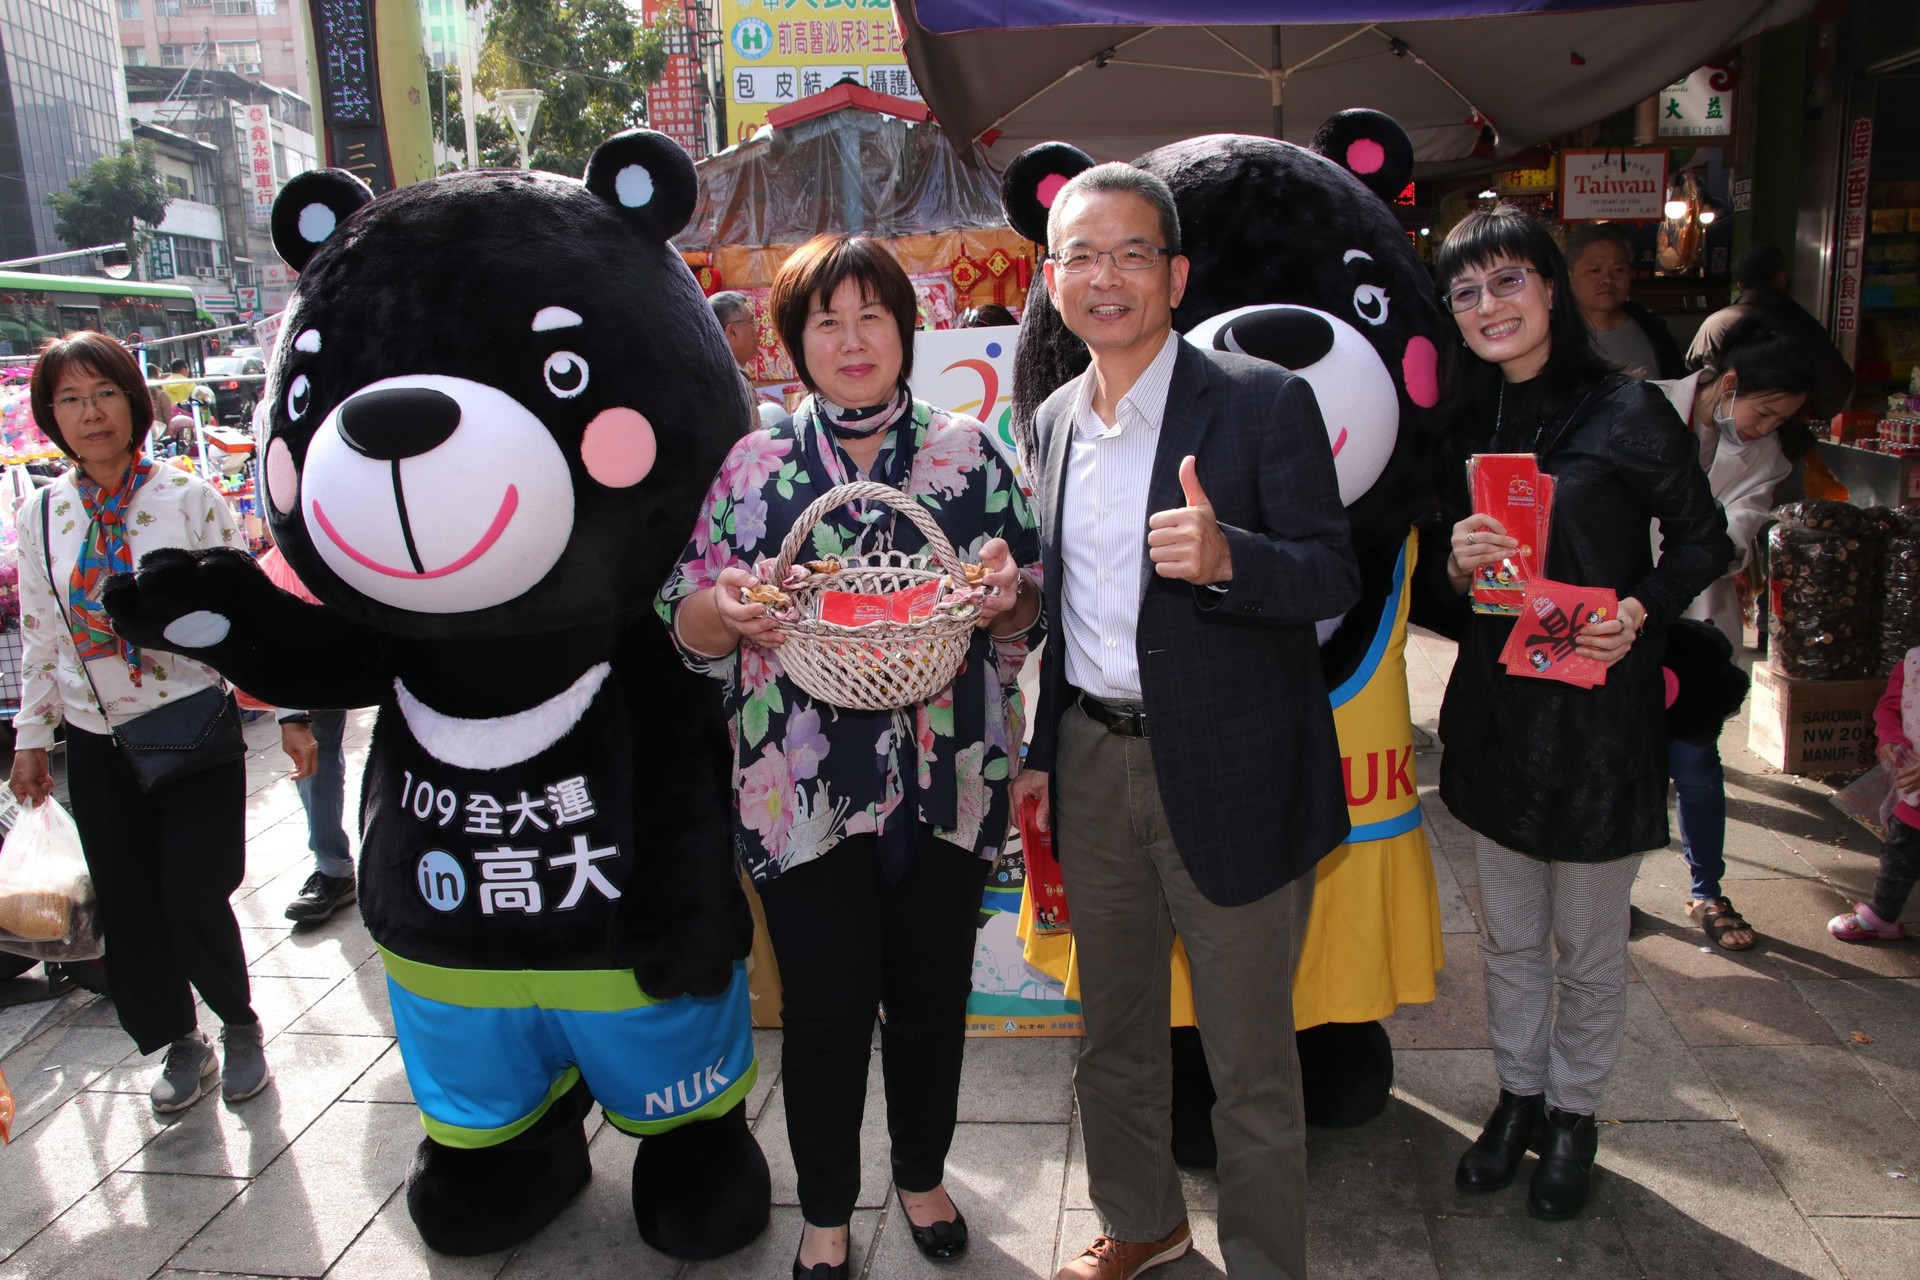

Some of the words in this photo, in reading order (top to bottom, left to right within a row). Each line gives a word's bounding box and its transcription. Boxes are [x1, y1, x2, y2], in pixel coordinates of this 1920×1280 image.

[250, 125, 274, 205] 鑫永勝車行
[1573, 174, 1657, 195] Taiwan
[1838, 118, 1873, 332] 偉香進口食品
[1802, 709, 1862, 724] SAROMA
[1803, 727, 1835, 743] NW
[422, 860, 459, 902] in
[473, 834, 622, 915] 高大
[645, 1055, 730, 1115] NUK
